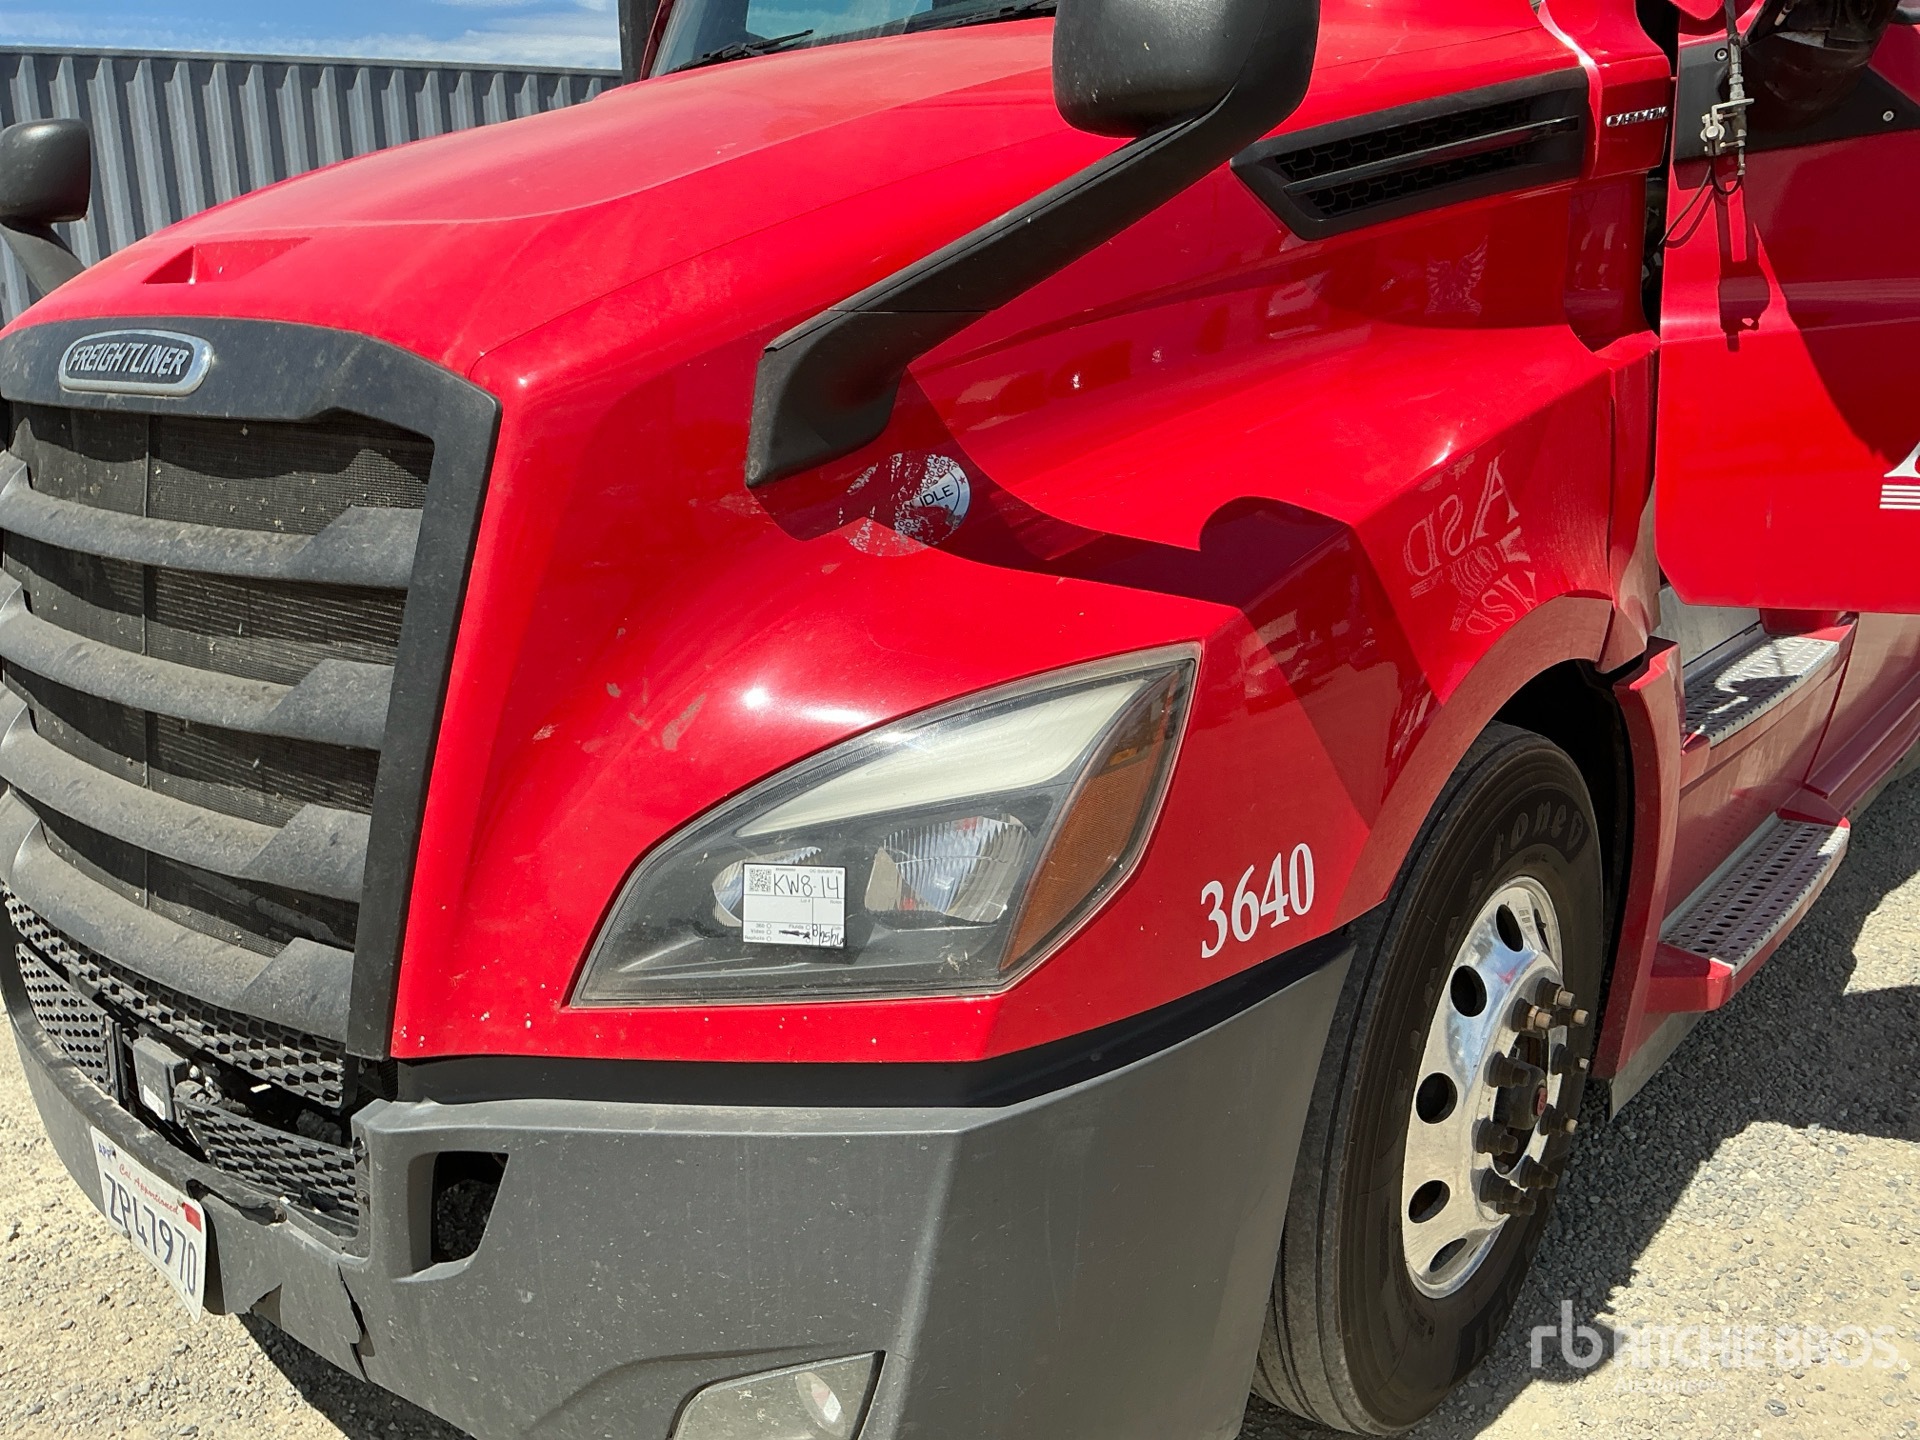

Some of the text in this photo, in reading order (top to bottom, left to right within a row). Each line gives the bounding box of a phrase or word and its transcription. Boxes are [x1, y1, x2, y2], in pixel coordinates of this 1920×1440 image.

[68, 342, 188, 376] FREIGHTLINER
[919, 485, 954, 507] IDLE
[1200, 843, 1315, 959] 3640
[104, 1172, 197, 1296] ZP47970
